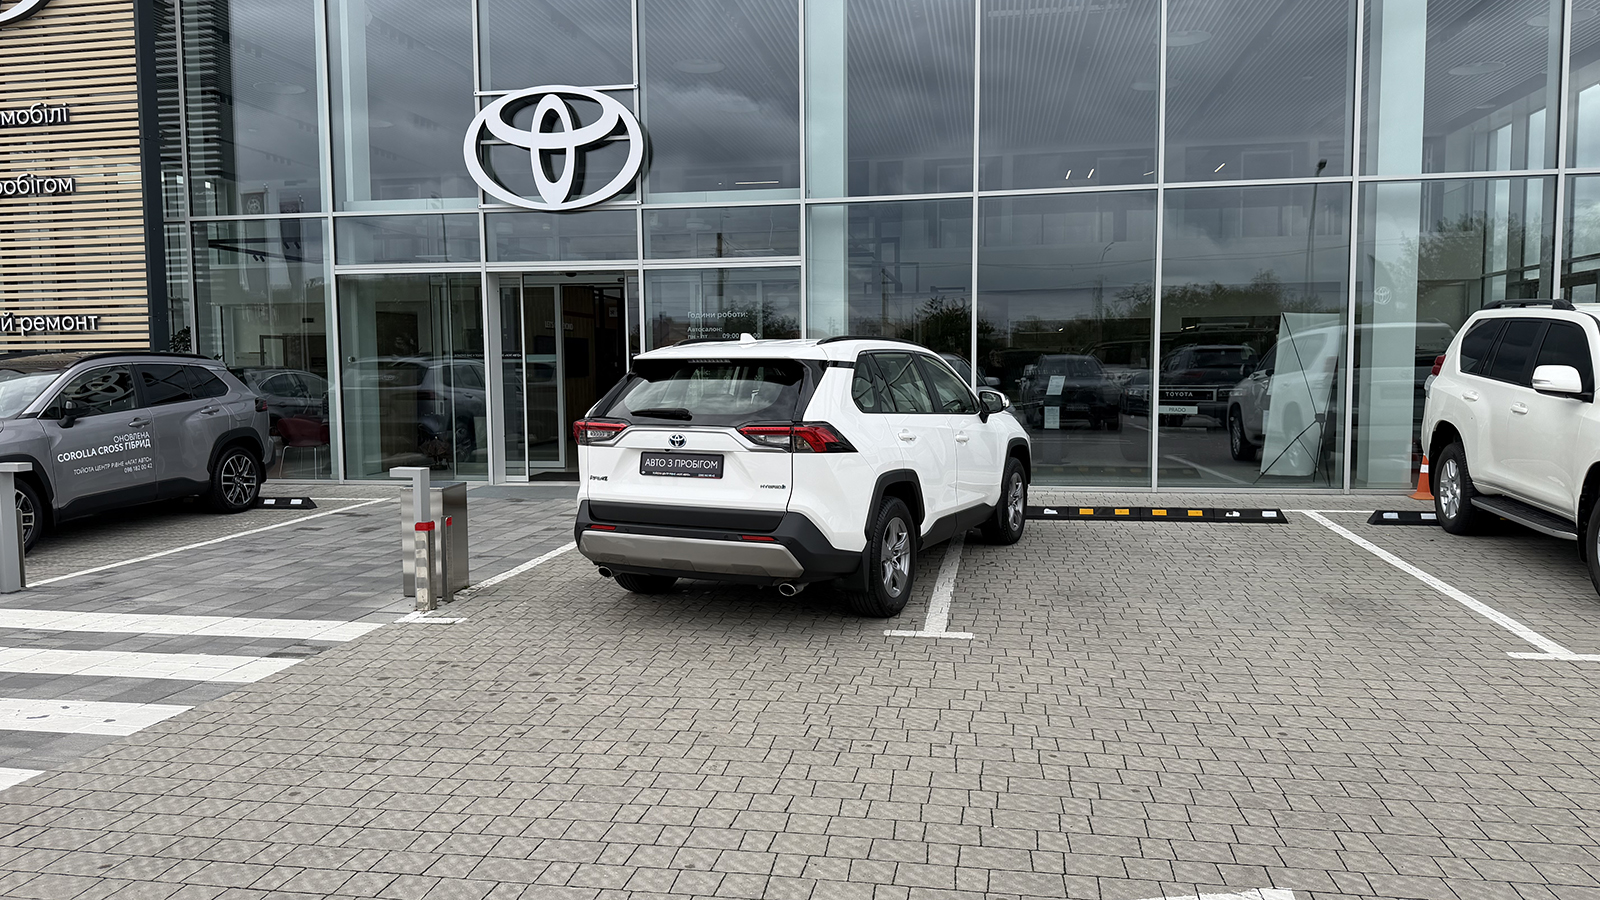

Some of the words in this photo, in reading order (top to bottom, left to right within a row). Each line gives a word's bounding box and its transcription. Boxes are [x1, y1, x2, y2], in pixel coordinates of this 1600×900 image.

[687, 311, 716, 319] Години
[717, 310, 749, 319] роботи:
[20, 315, 98, 336] ремонт
[113, 431, 150, 444] ОНОВЛЕНА
[57, 448, 97, 463] COROLLA
[98, 443, 124, 455] CROSS
[124, 438, 151, 451] ГІБРИД
[644, 458, 666, 468] АВТО
[674, 459, 718, 470] ПРОБІГОМ
